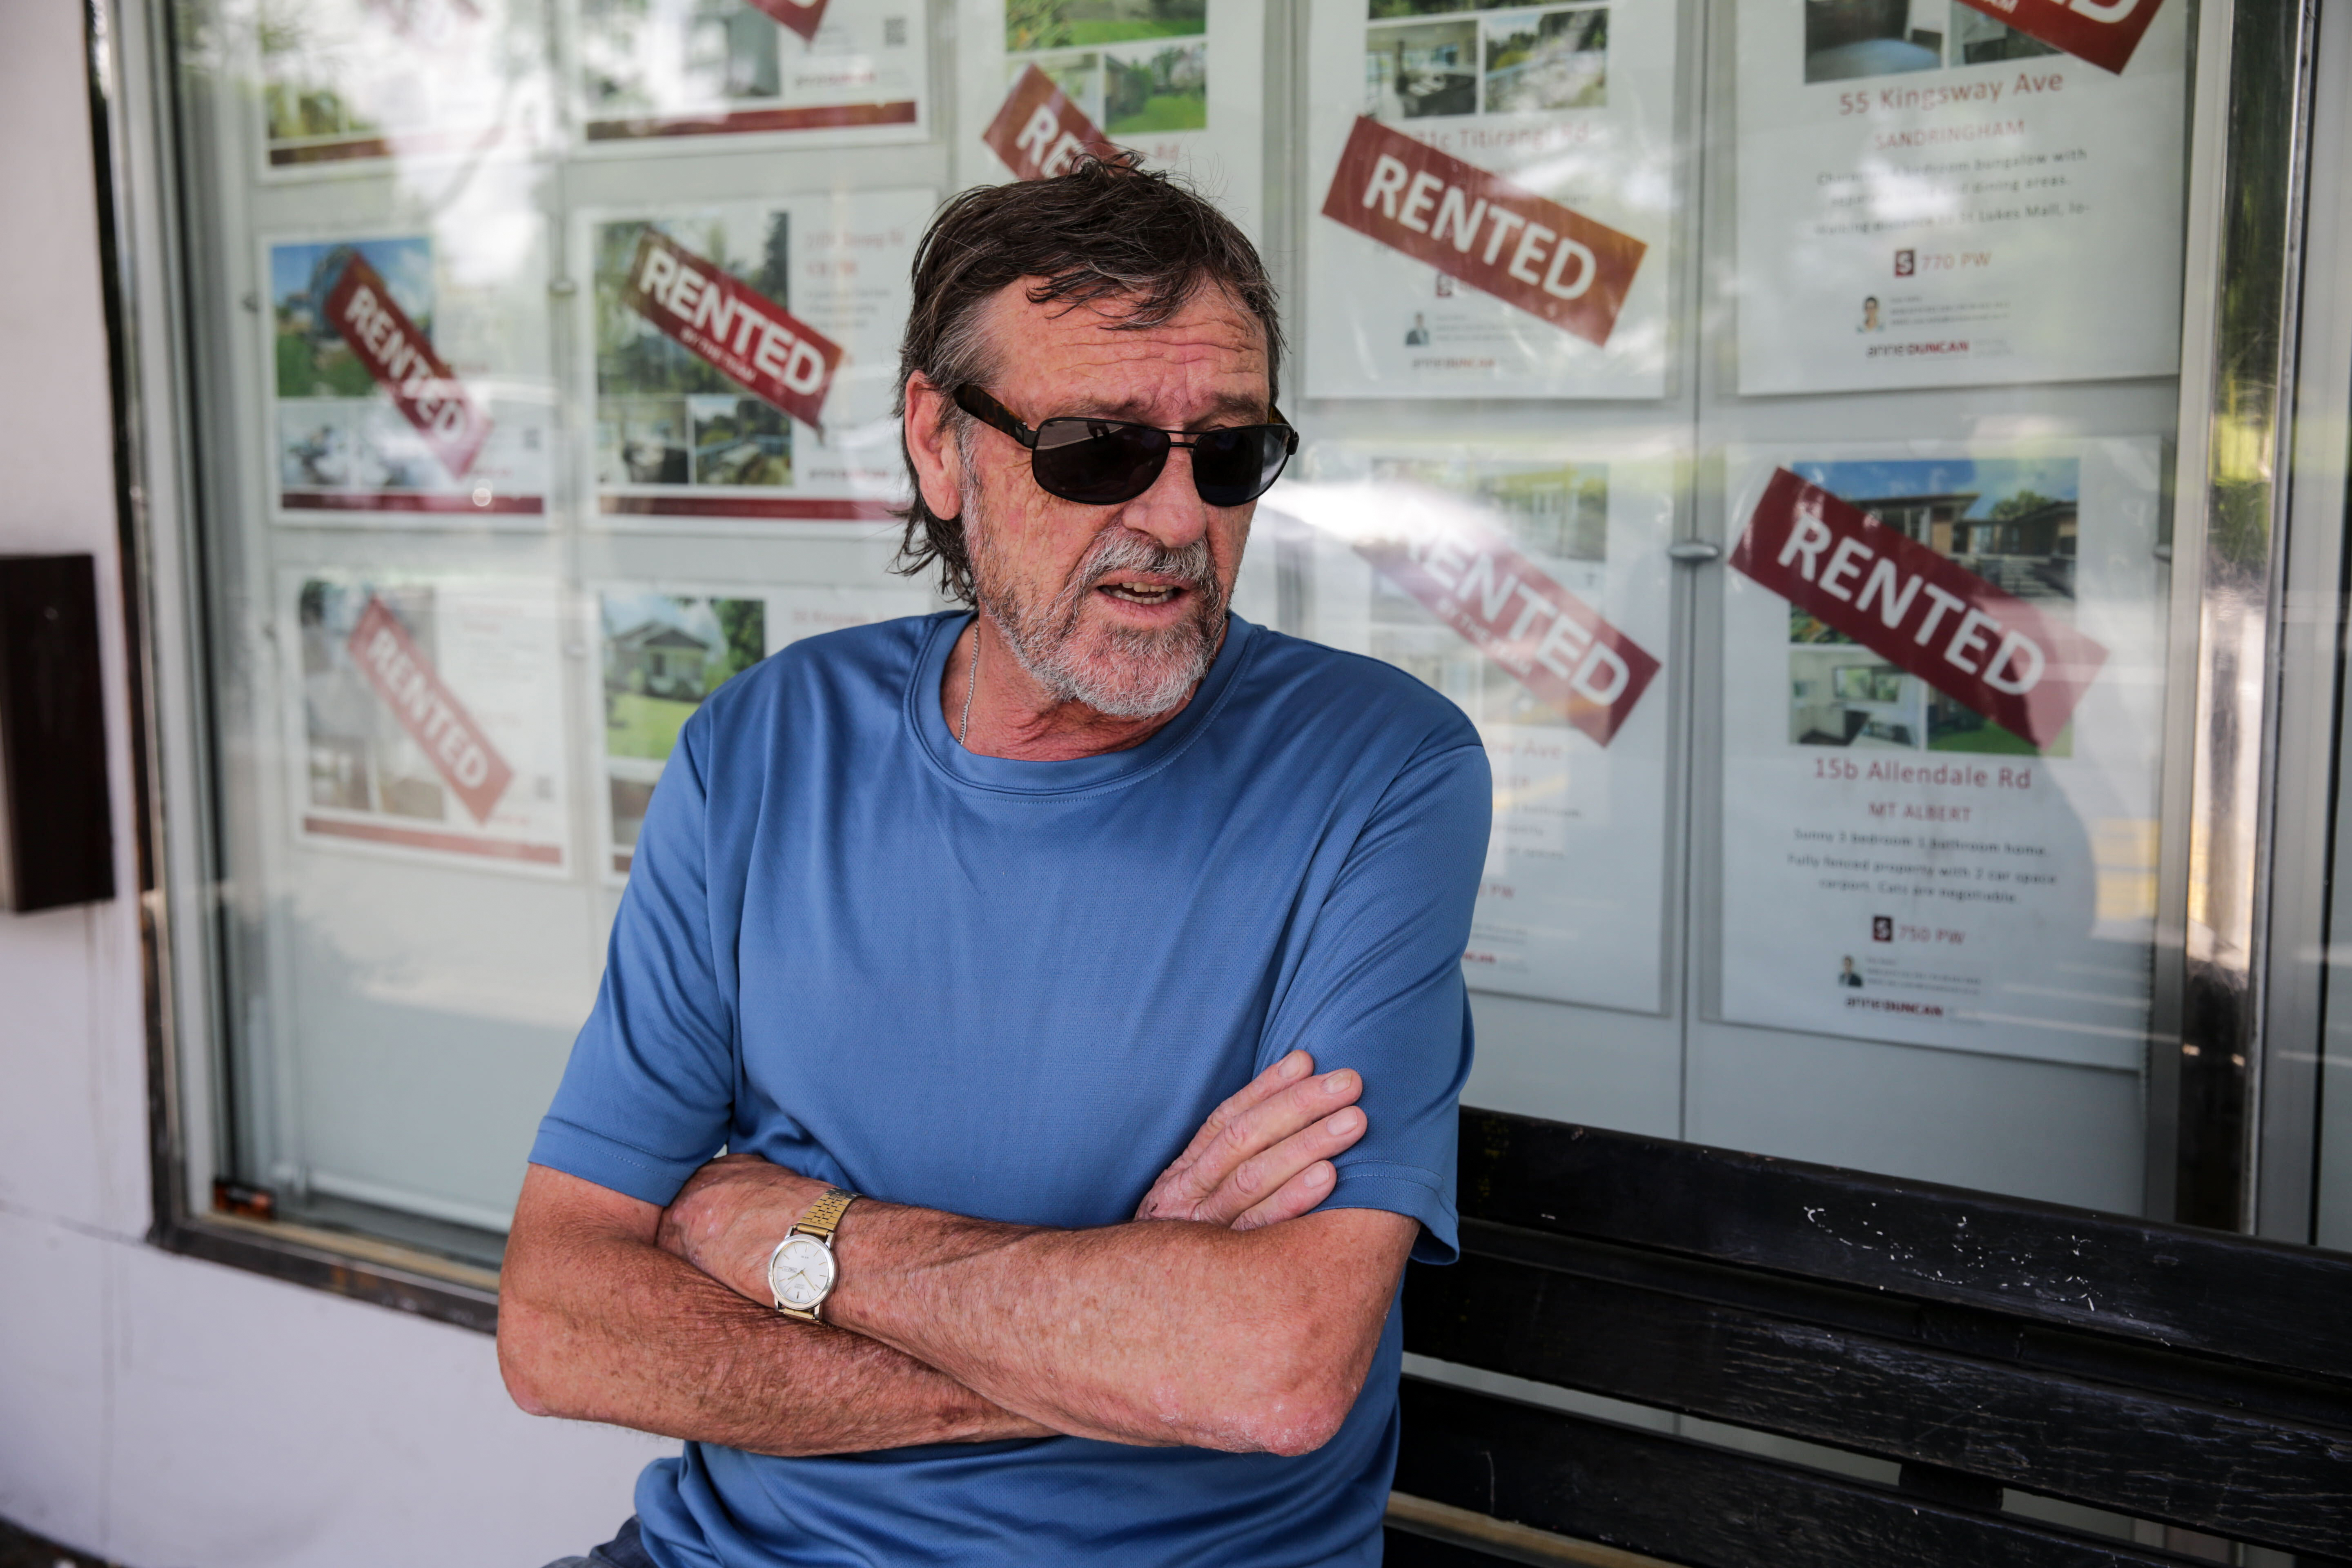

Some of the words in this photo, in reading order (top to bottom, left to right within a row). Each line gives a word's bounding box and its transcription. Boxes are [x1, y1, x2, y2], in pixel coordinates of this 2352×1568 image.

[1839, 90, 1871, 116] 55
[1879, 80, 2004, 111] Kingsway
[2012, 72, 2064, 96] Ave
[1874, 120, 2025, 150] SANDRINGHAM
[2051, 145, 2087, 163] with
[1362, 154, 1596, 300] RENTED
[1921, 253, 1955, 271] 770
[1960, 251, 1993, 268] PW
[639, 247, 826, 396] RENTED
[345, 285, 466, 442] RENTED
[1777, 513, 2044, 695] RENTED
[368, 628, 488, 790] RENTED
[1813, 757, 1859, 780] 15b
[1866, 758, 1989, 788] Allendale
[1997, 765, 2032, 790] Rd
[1868, 801, 1898, 819] MT
[1902, 802, 1973, 823] ALBERT
